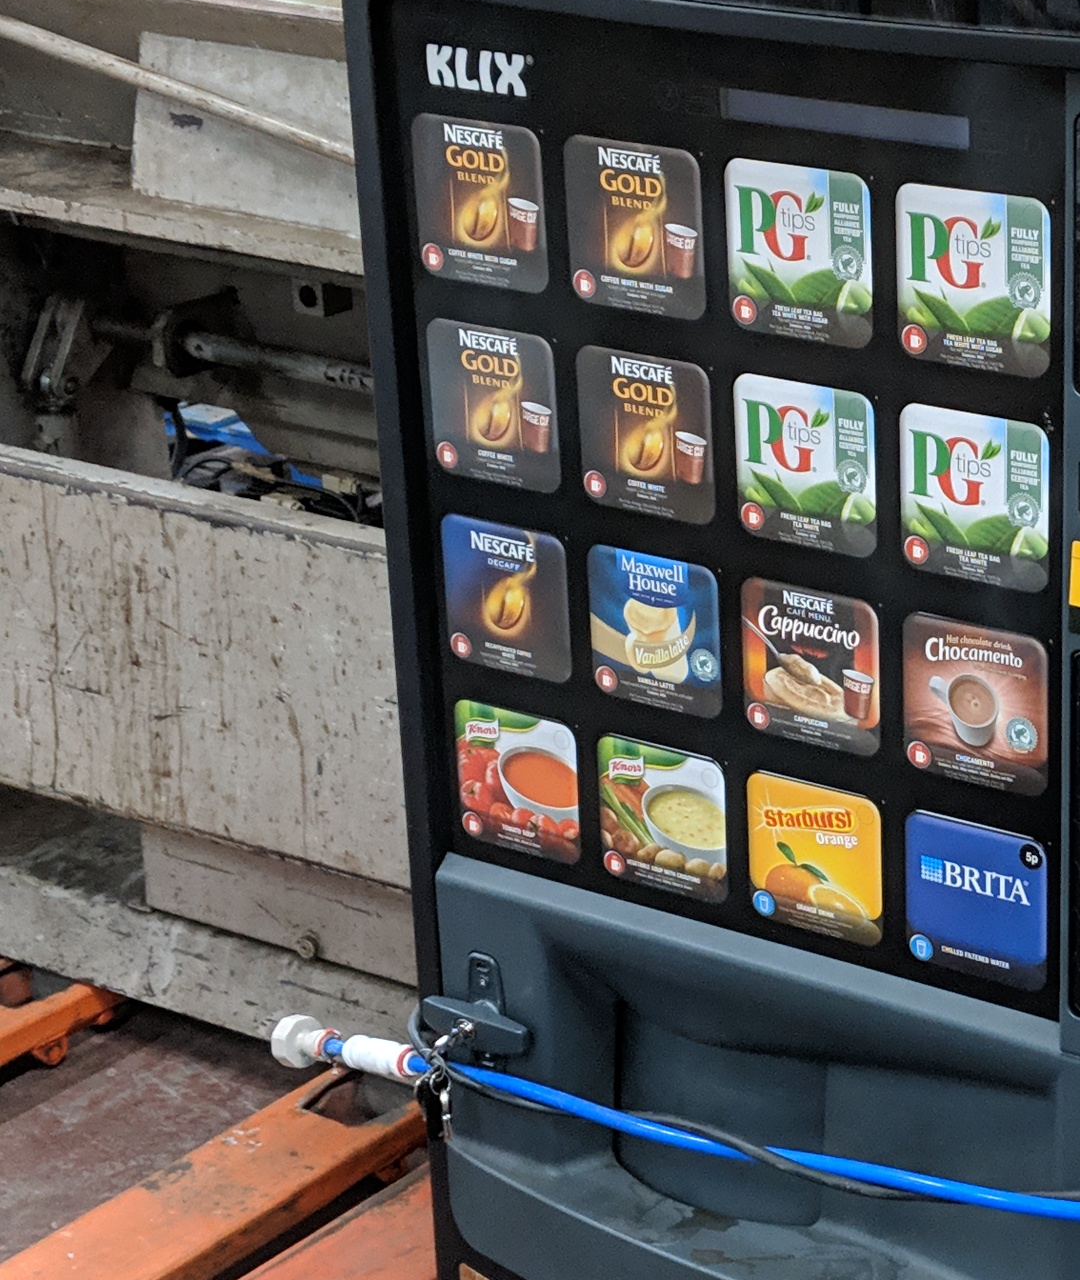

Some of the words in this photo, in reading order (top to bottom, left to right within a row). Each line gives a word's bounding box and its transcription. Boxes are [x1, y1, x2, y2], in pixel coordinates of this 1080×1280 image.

[426, 43, 527, 97] KLIX
[443, 123, 504, 149] NESCAFÉ
[445, 145, 505, 172] GOLD
[598, 146, 662, 174] NESCAFÉ
[457, 171, 495, 185] BLEND
[600, 169, 662, 198] GOLD
[611, 195, 651, 210] BLEND
[832, 201, 859, 215] FULLY
[734, 185, 809, 262] PG
[780, 207, 815, 232] tips
[1011, 227, 1039, 241] FULLY
[906, 211, 984, 289] PG
[954, 234, 991, 259] tips
[458, 328, 519, 355] NESCAFÉ
[461, 349, 518, 377] GOLD
[611, 356, 675, 384] NESCAFÉ
[472, 374, 510, 389] BLEND
[612, 377, 673, 406] GOLD
[624, 403, 664, 417] BLEND
[742, 398, 814, 473] PG
[787, 421, 821, 446] tips
[838, 418, 864, 431] FULLY
[909, 429, 984, 506] PG
[955, 453, 991, 477] tips
[1010, 450, 1038, 464] FULLY
[470, 530, 535, 562] NESCAFÉ
[487, 558, 520, 570] DECAFF
[621, 554, 684, 583] Maxwell
[629, 573, 677, 596] House
[783, 590, 834, 614] NESCAFÉ
[758, 605, 860, 650] Cappuccino
[635, 646, 670, 664] Vanilla
[669, 635, 689, 658] latte
[925, 637, 1023, 668] Chocamento
[946, 634, 958, 644] Hot
[960, 635, 992, 648] chocolate
[993, 640, 1012, 651] drink
[468, 724, 497, 735] Knorr
[611, 761, 641, 772] Knorr
[764, 808, 853, 829] Starburst
[816, 832, 858, 849] Orange
[1025, 852, 1039, 865] 5p
[944, 860, 1031, 906] BRITA
[941, 945, 963, 957] CHILLED
[965, 951, 989, 963] FILTERED
[990, 958, 1010, 969] WATER
